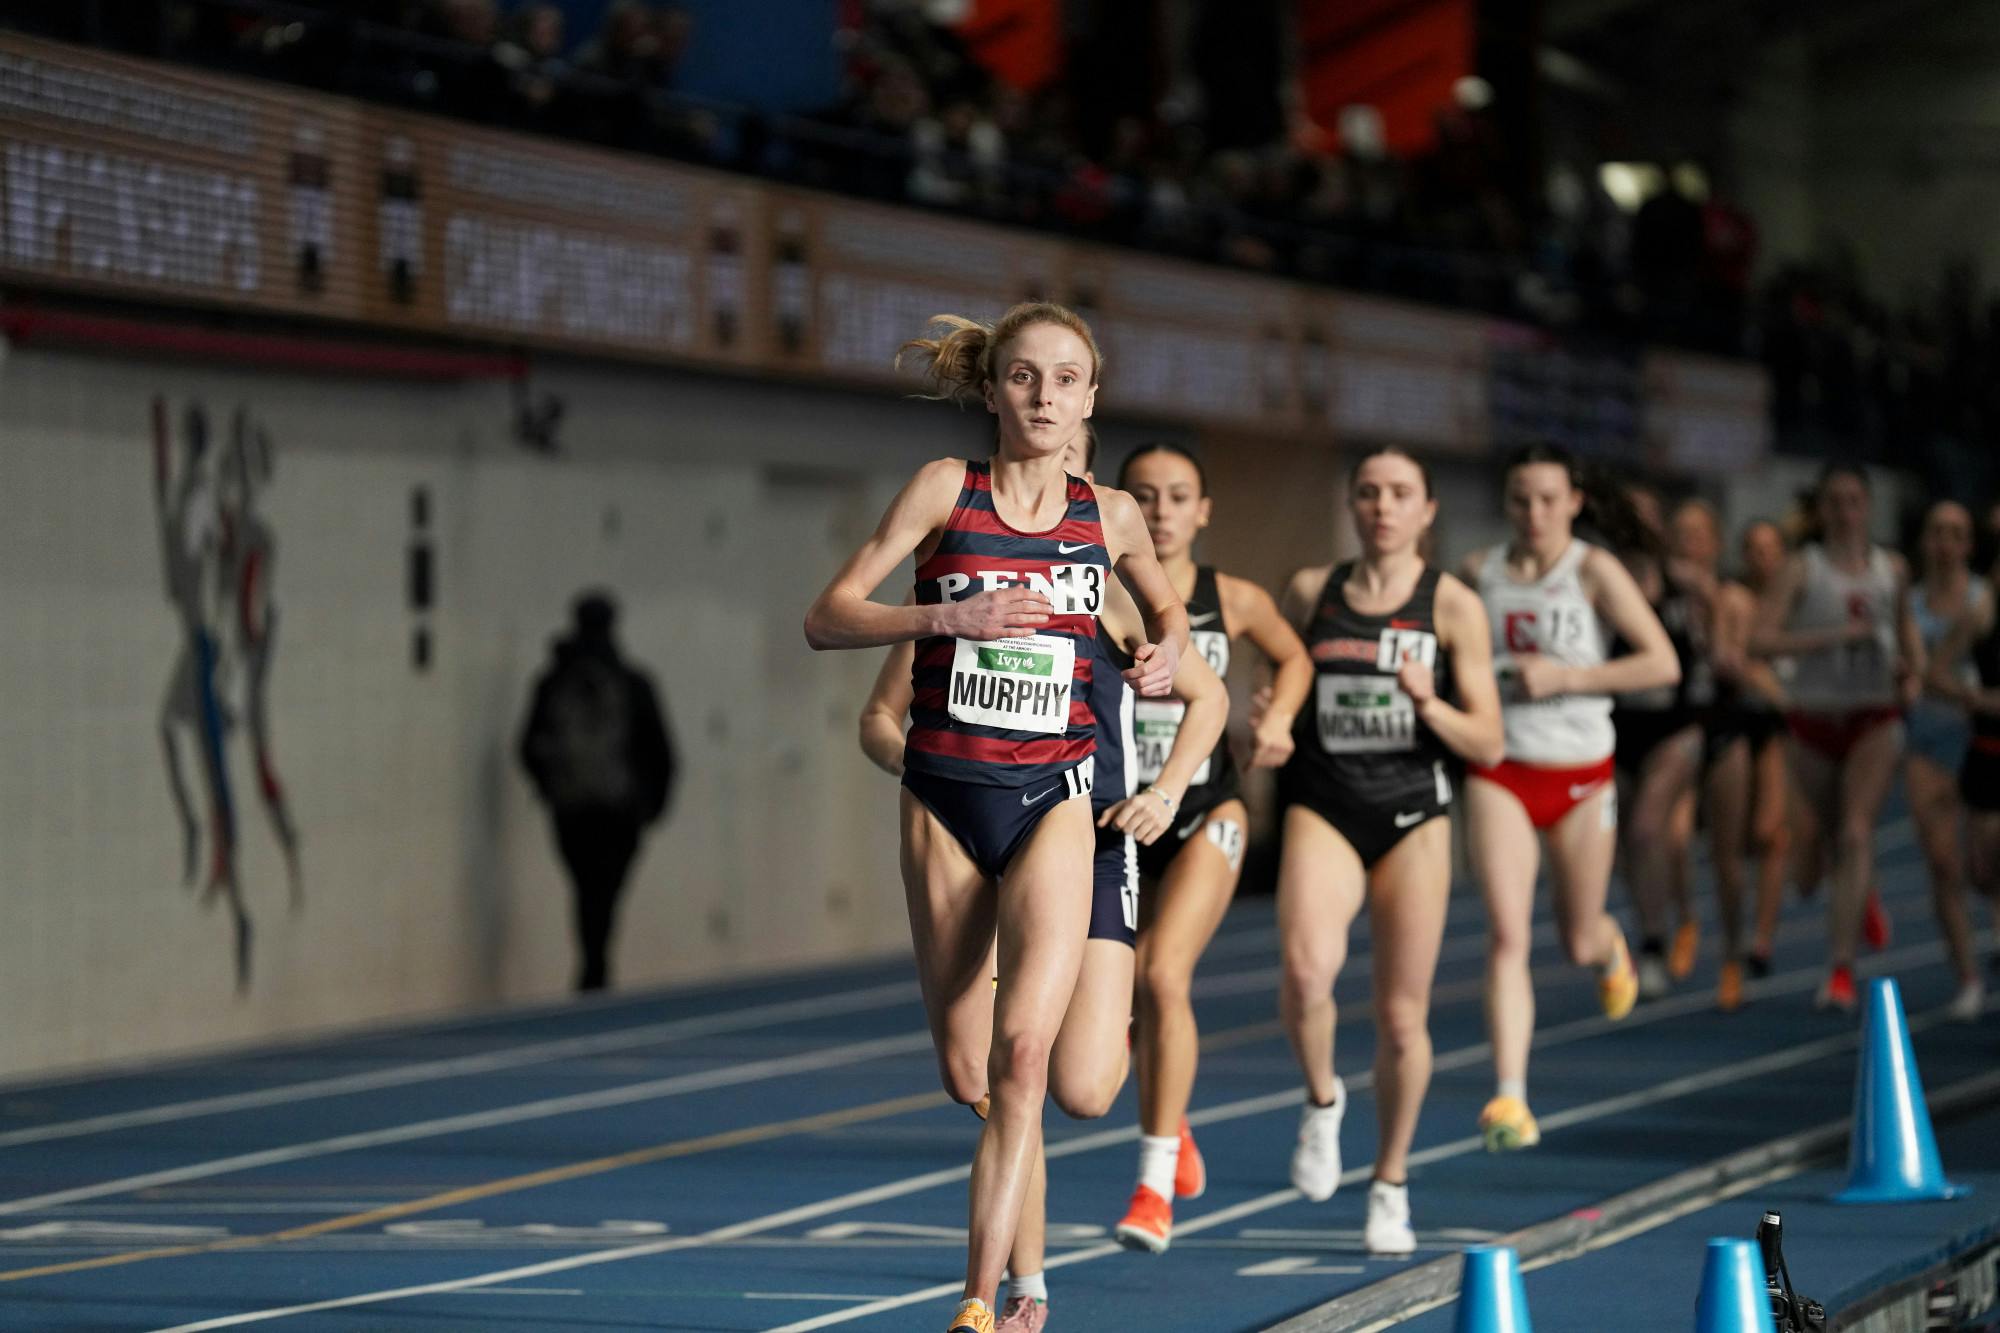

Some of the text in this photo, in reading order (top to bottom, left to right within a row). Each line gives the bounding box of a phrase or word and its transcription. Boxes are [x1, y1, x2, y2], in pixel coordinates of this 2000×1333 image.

[1056, 566, 1100, 612] 13
[997, 652, 1022, 670] Ivy
[952, 671, 1069, 717] MURPHY
